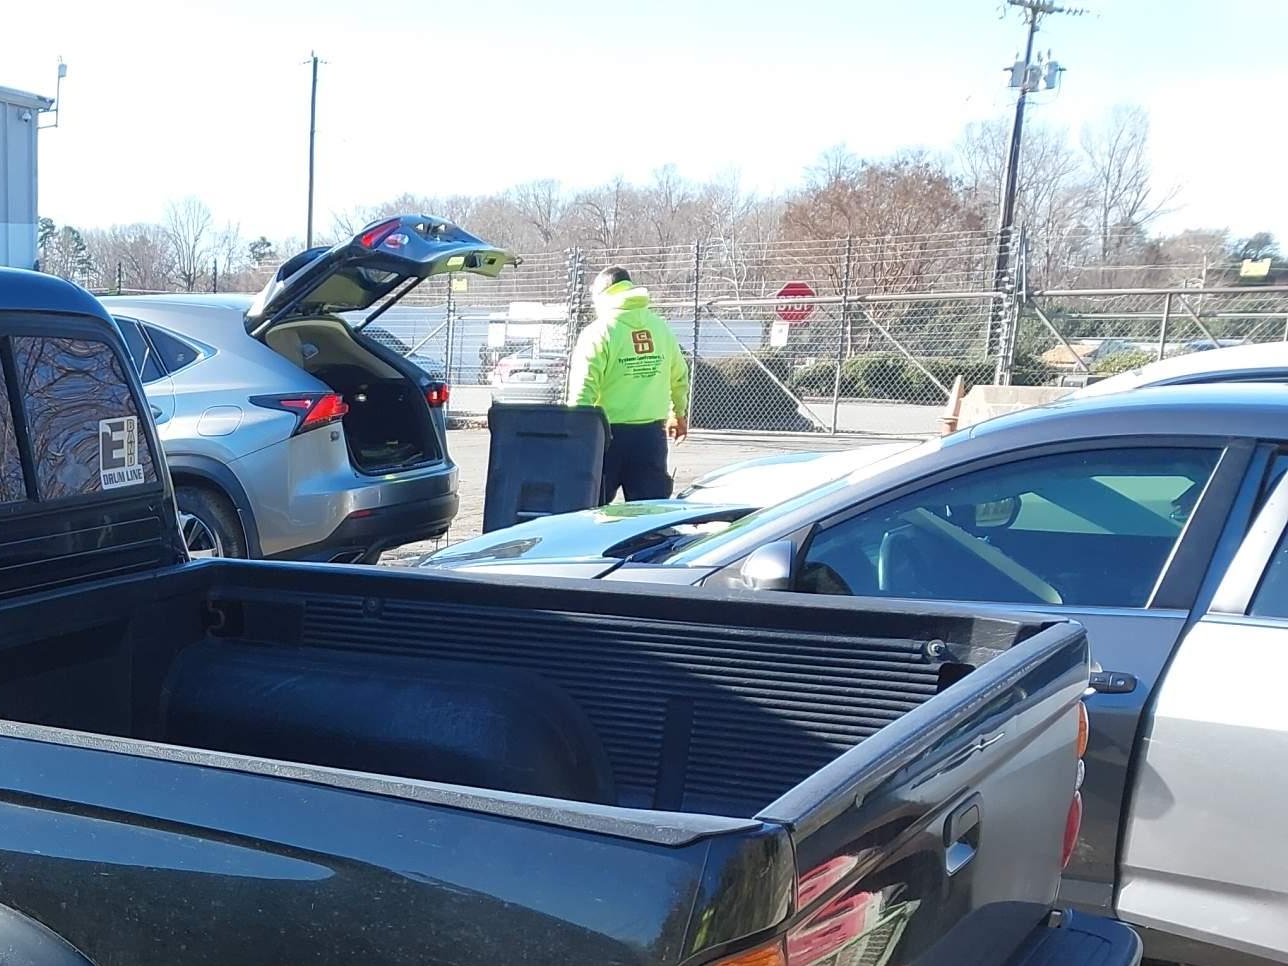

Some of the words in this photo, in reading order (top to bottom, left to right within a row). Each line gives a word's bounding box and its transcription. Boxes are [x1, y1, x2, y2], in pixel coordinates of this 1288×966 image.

[102, 421, 125, 471] E
[127, 419, 136, 467] BAND
[103, 471, 126, 485] DRUM
[126, 468, 143, 481] LINE
